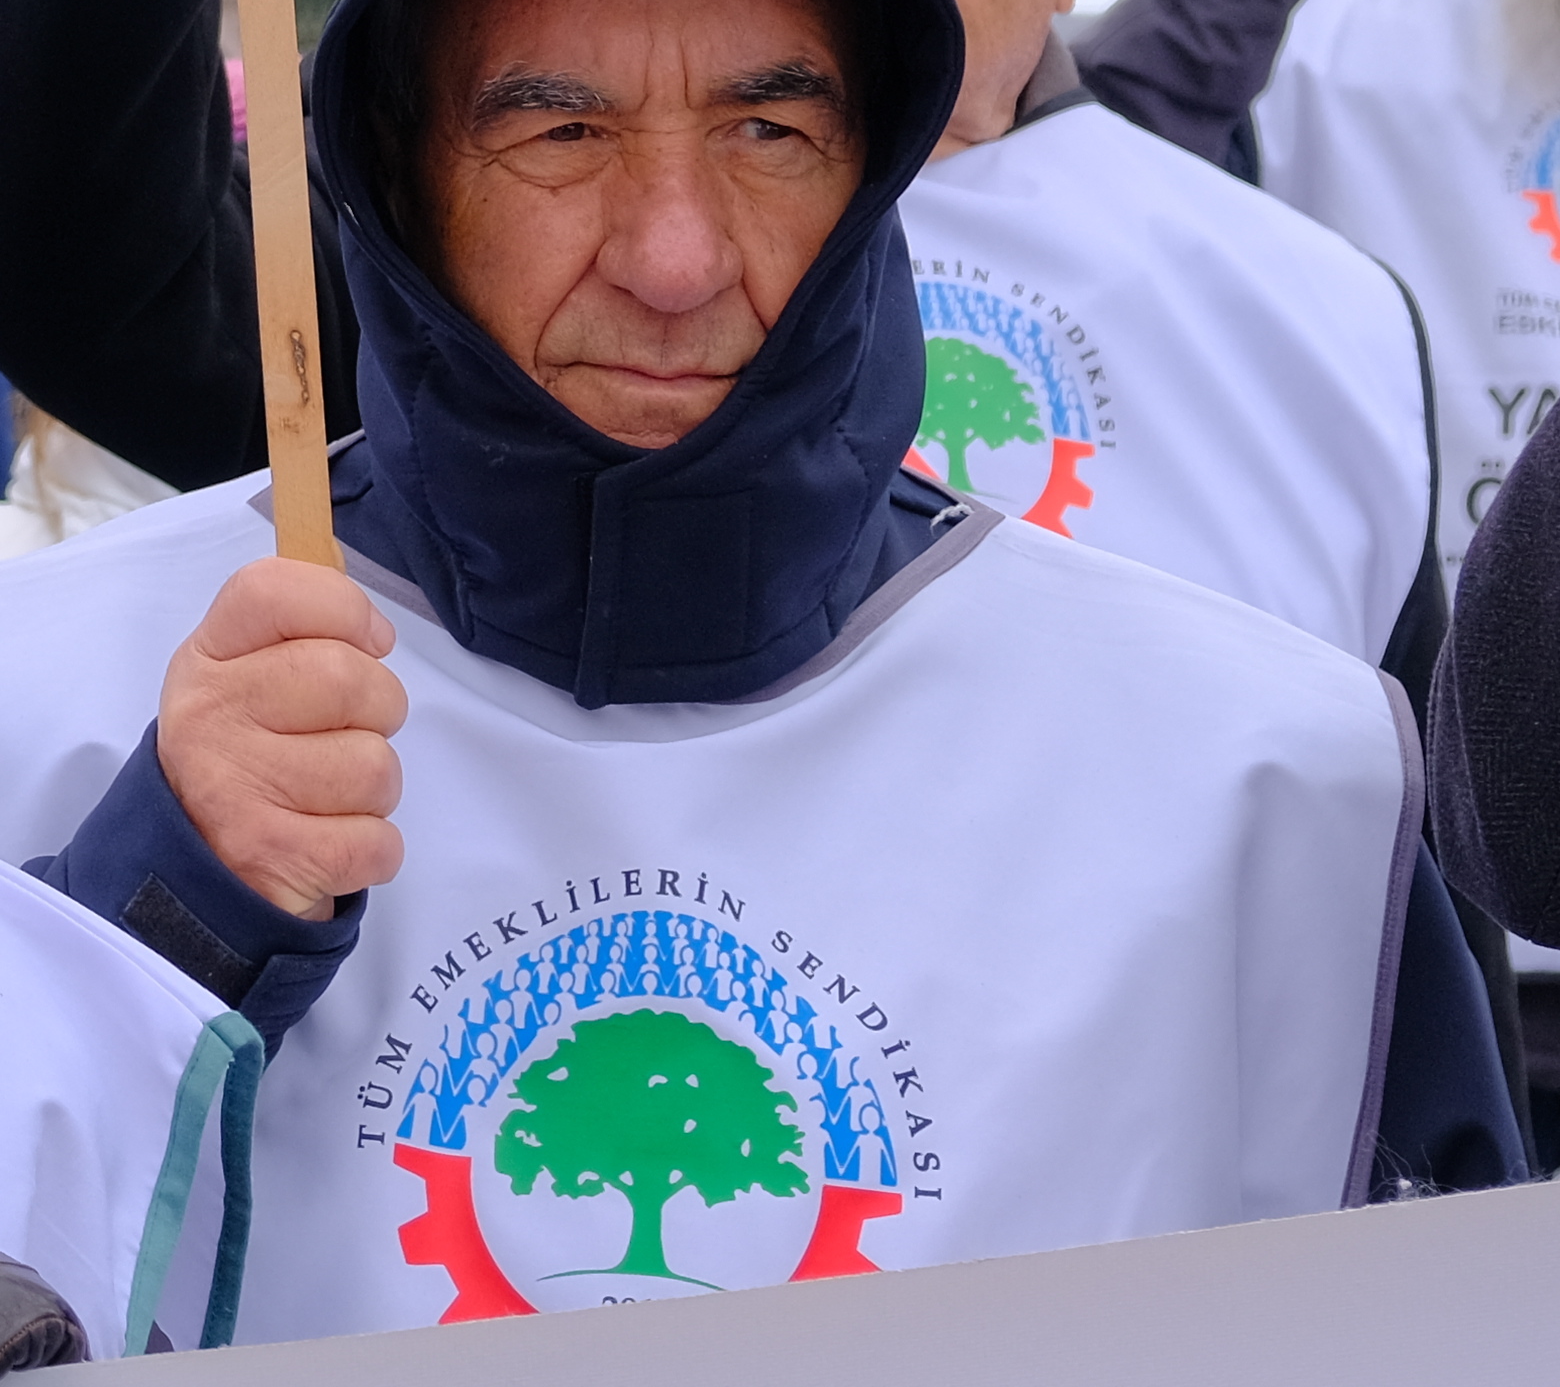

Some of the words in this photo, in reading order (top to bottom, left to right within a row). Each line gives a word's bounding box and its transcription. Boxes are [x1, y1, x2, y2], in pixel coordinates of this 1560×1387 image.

[912, 259, 991, 284] ERİN
[357, 1031, 412, 1148] TÜM
[409, 867, 747, 1014] EMEKLİLERİN
[771, 928, 943, 1201] SENDİKASI
